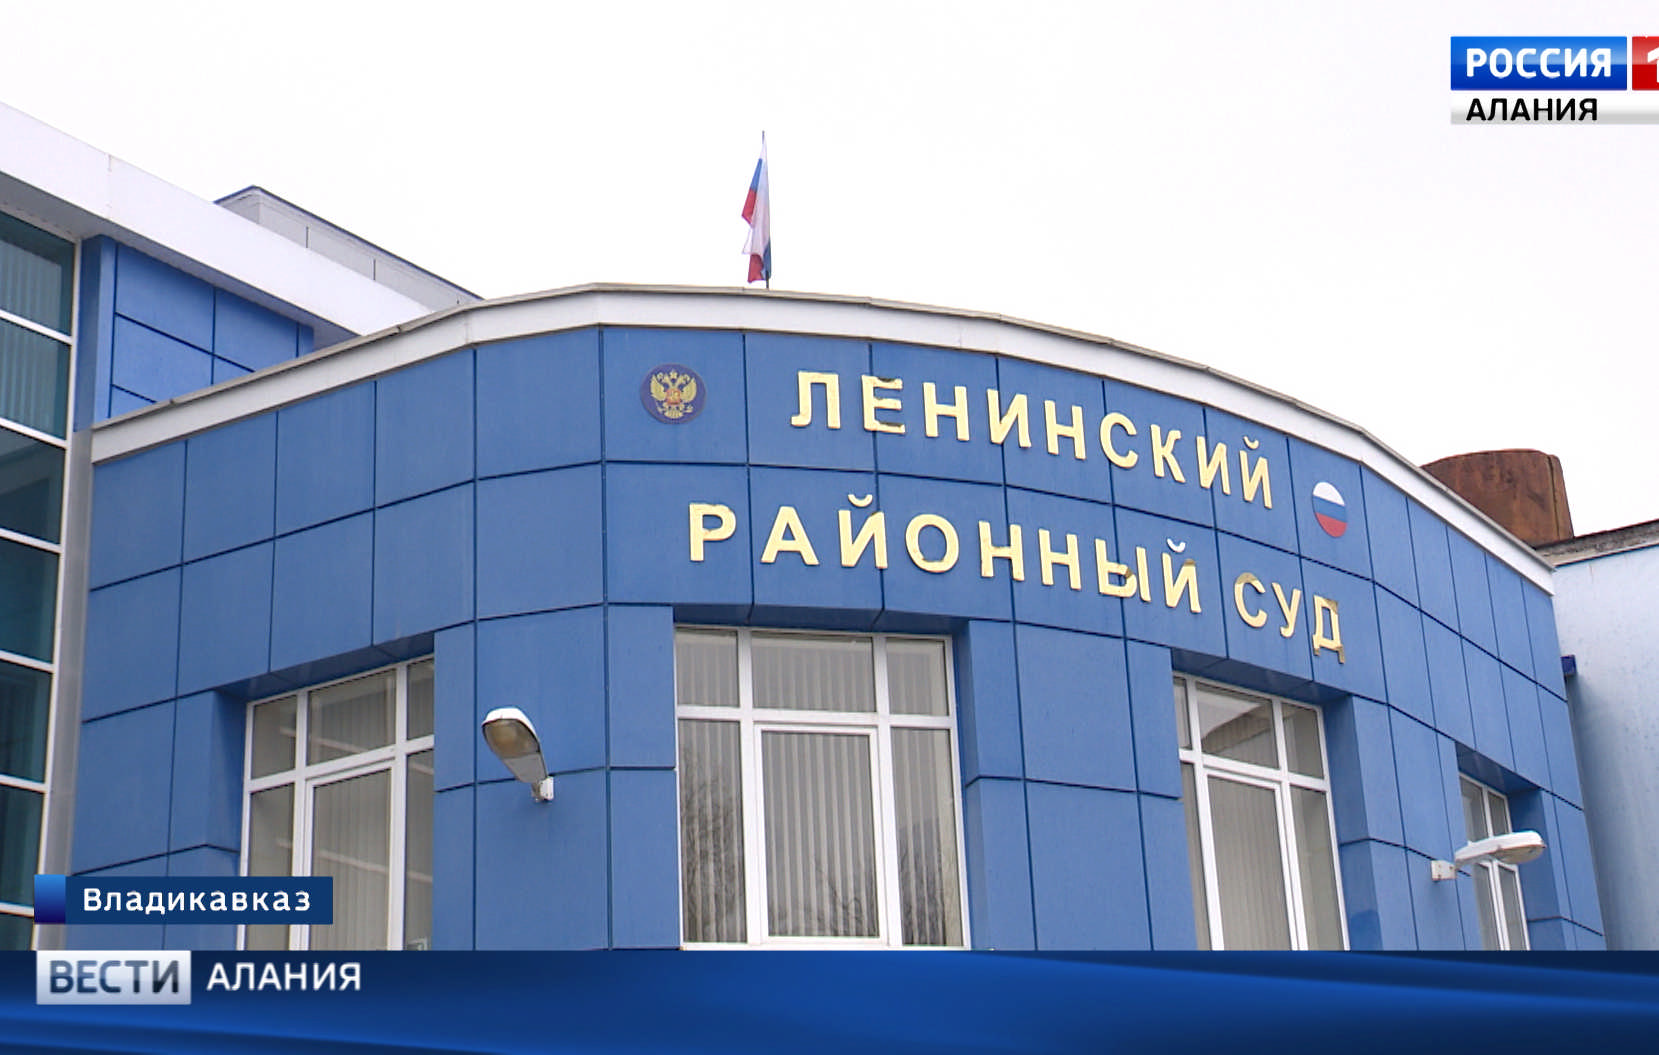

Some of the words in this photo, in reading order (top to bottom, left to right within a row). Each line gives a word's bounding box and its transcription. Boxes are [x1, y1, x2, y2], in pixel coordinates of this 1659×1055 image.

[791, 371, 1274, 510] ЛЕНИНСКИЙ
[688, 493, 1202, 614] РАЙОННЫЙ
[1233, 572, 1346, 664] СУД
